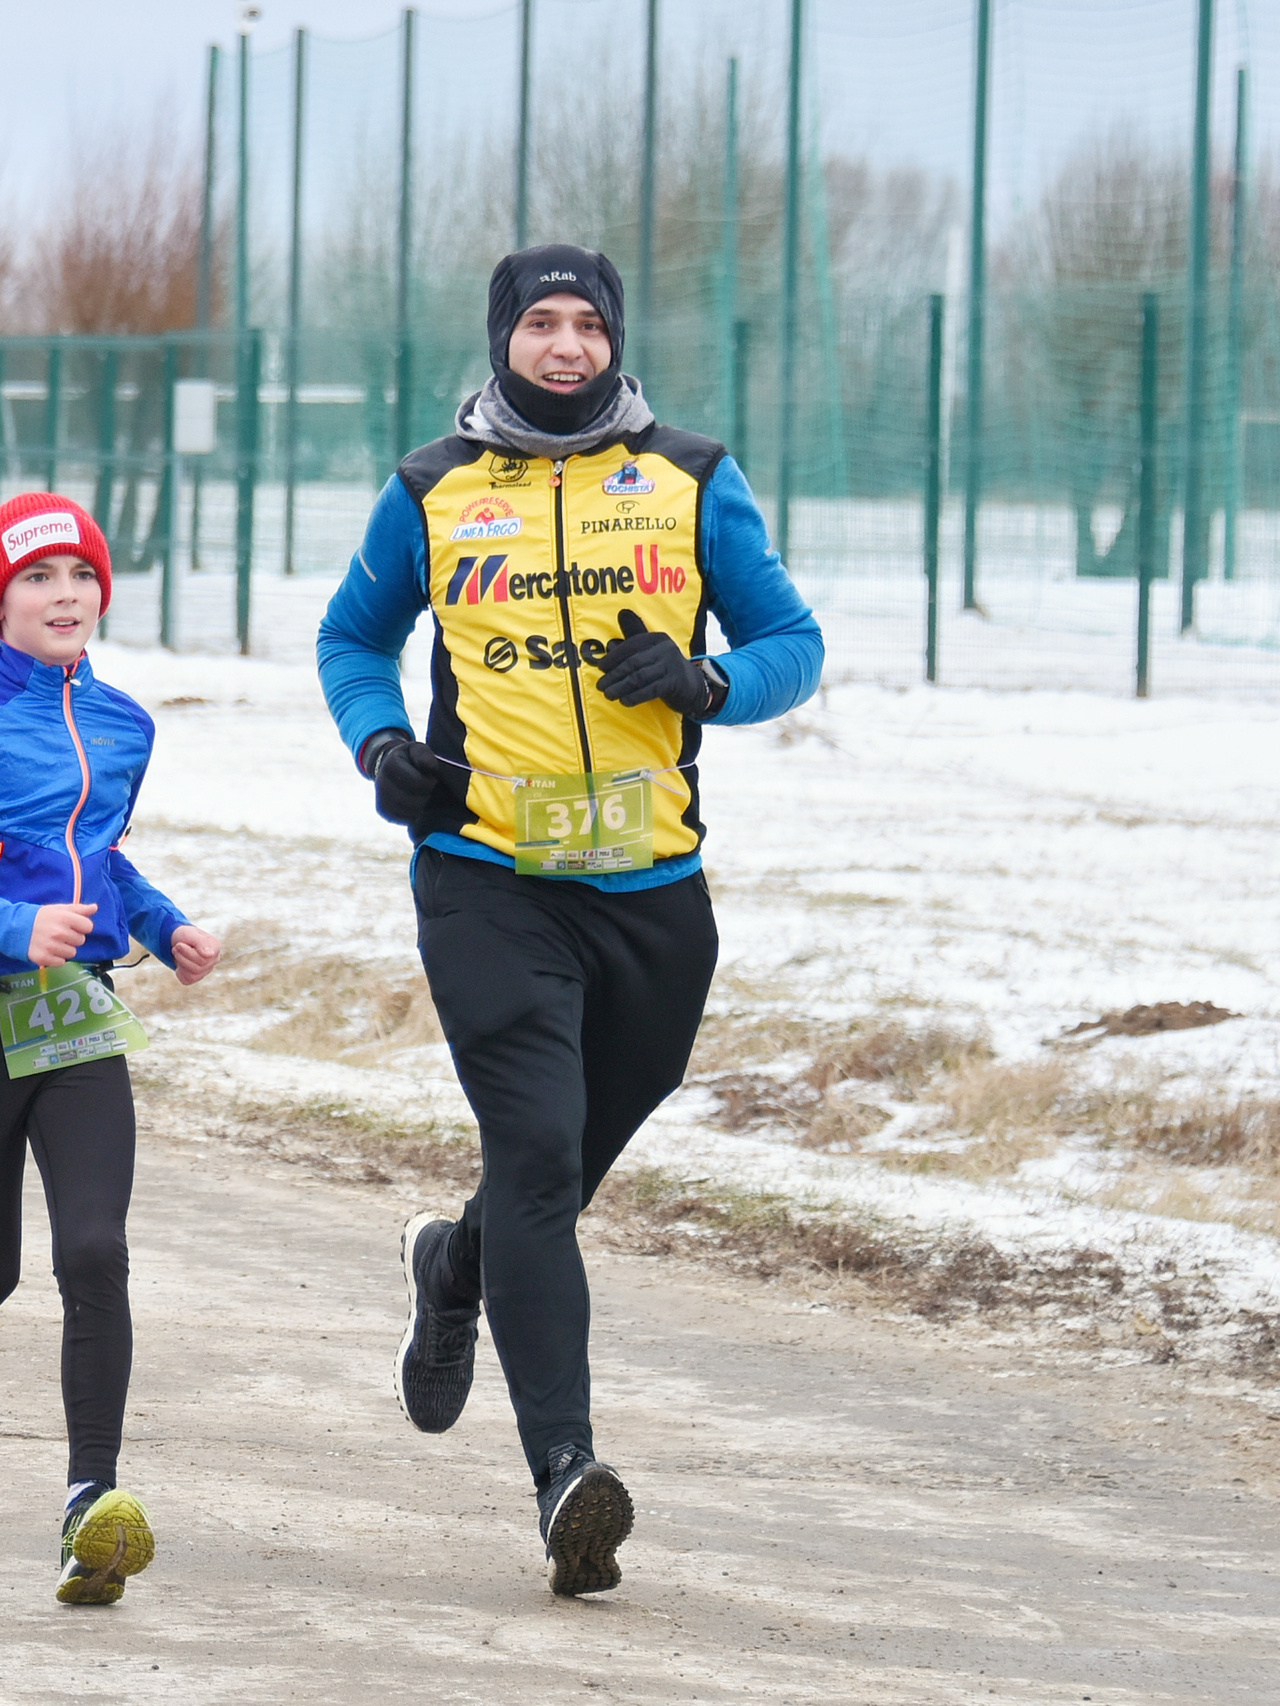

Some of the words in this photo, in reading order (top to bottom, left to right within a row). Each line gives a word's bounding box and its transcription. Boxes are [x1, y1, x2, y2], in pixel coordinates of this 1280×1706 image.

[7, 522, 73, 551] Supreme
[452, 526, 484, 540] LINEA
[486, 522, 518, 537] ERGO
[580, 516, 677, 534] PINARELLO
[546, 794, 626, 838] 376
[9, 978, 35, 989] ITAN
[28, 980, 113, 1032] 428
